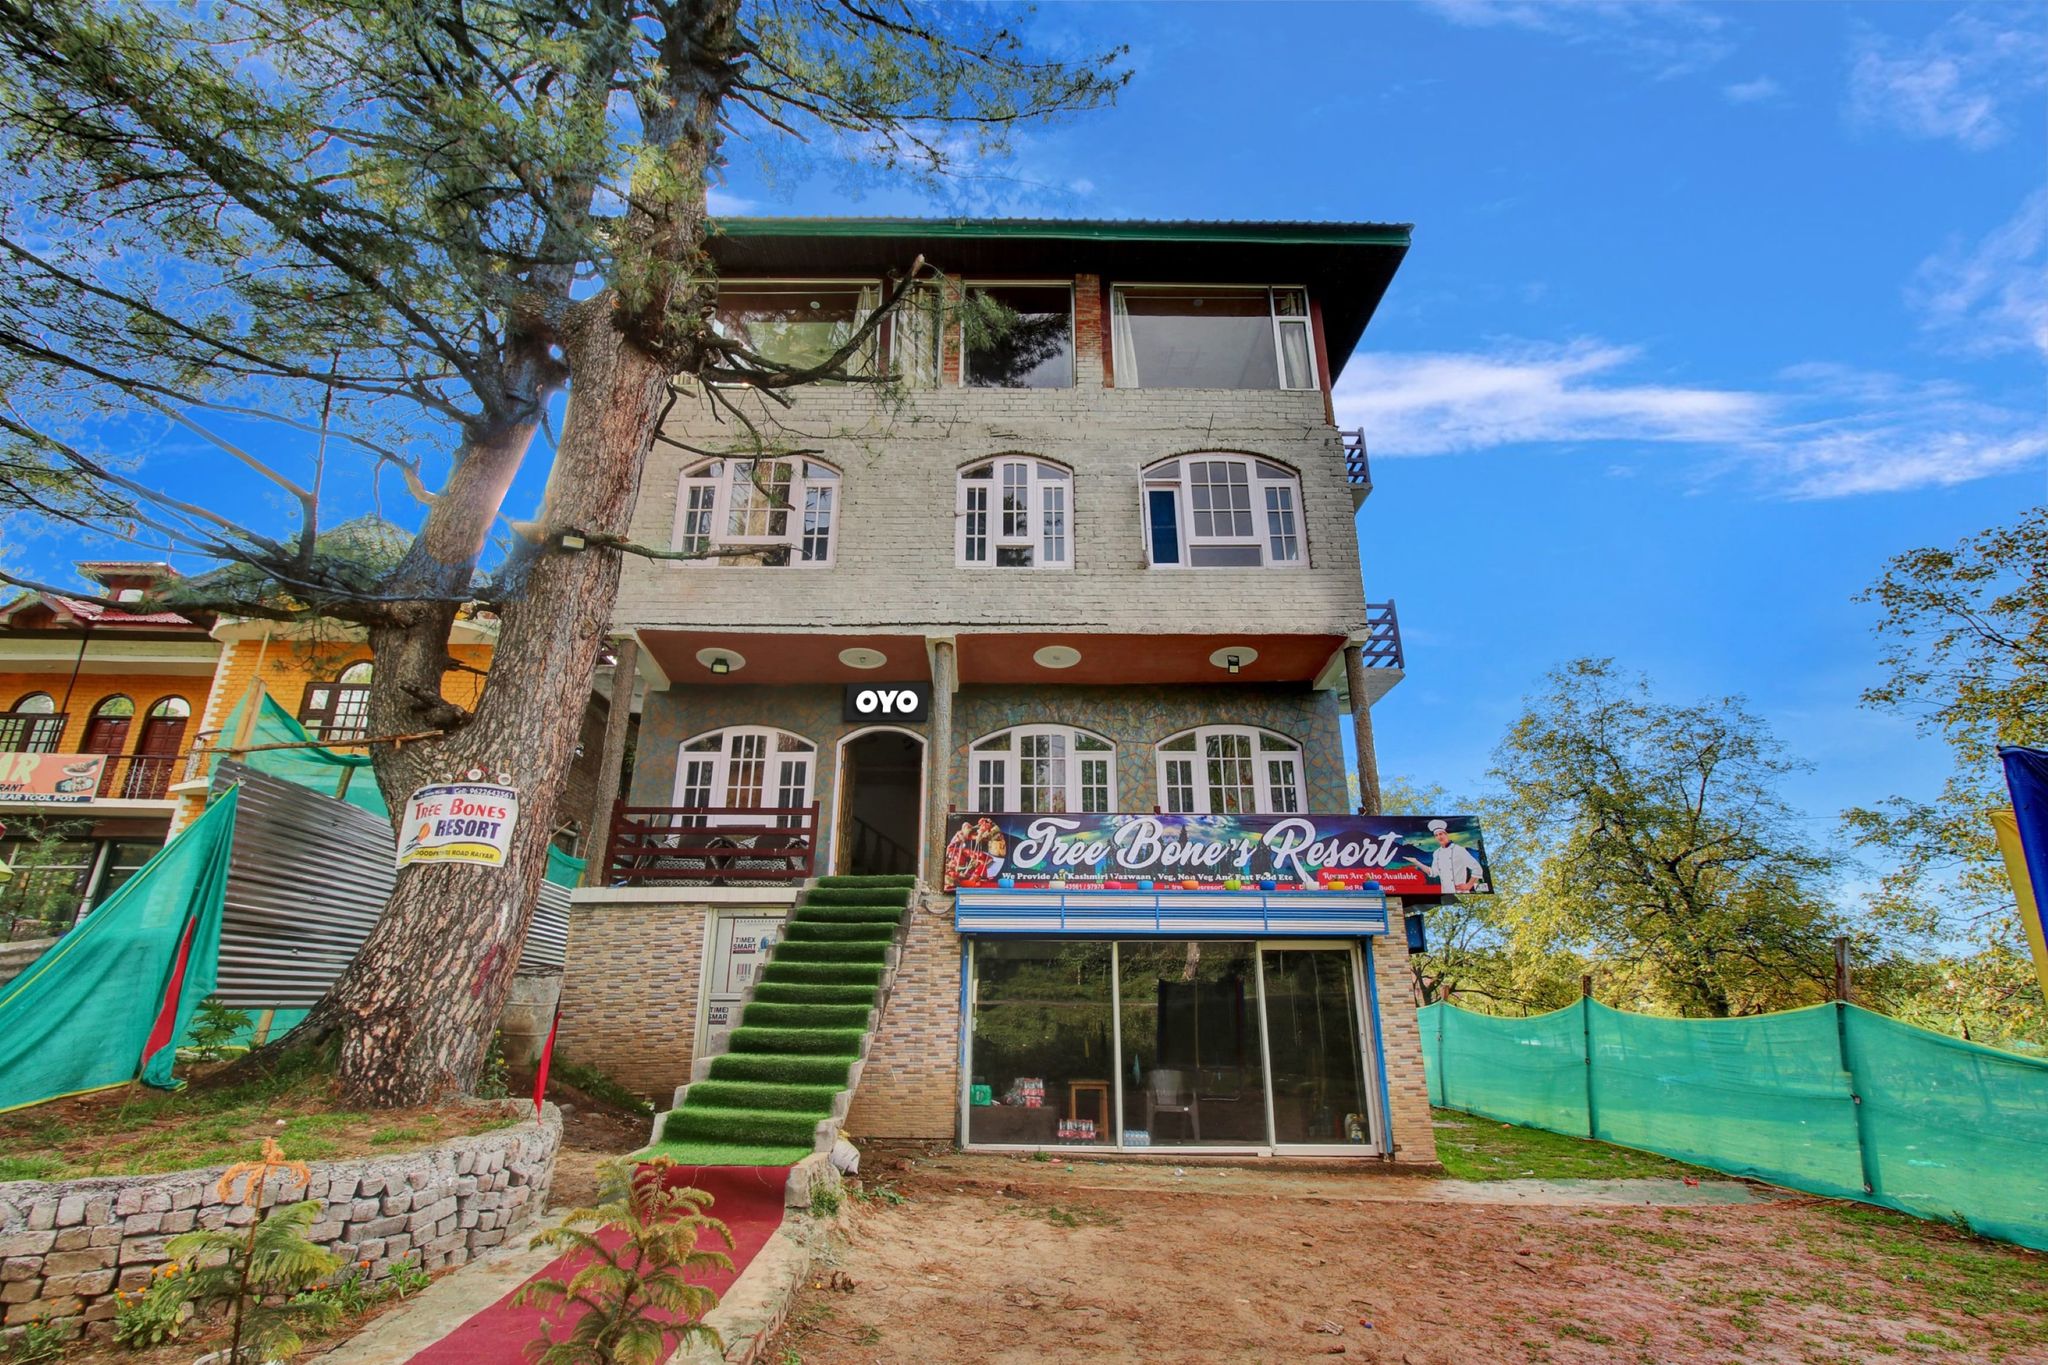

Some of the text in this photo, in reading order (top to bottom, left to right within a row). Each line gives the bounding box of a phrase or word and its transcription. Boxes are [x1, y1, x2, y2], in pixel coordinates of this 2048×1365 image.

[856, 690, 918, 713] OYO
[450, 798, 507, 819] BONES
[434, 819, 501, 839] RESORT
[1012, 817, 1403, 884] Tree Bone's Resort
[1197, 873, 1214, 882] Veg
[1349, 872, 1364, 880] Are
[1364, 872, 1382, 880] Also
[1382, 872, 1418, 880] Available
